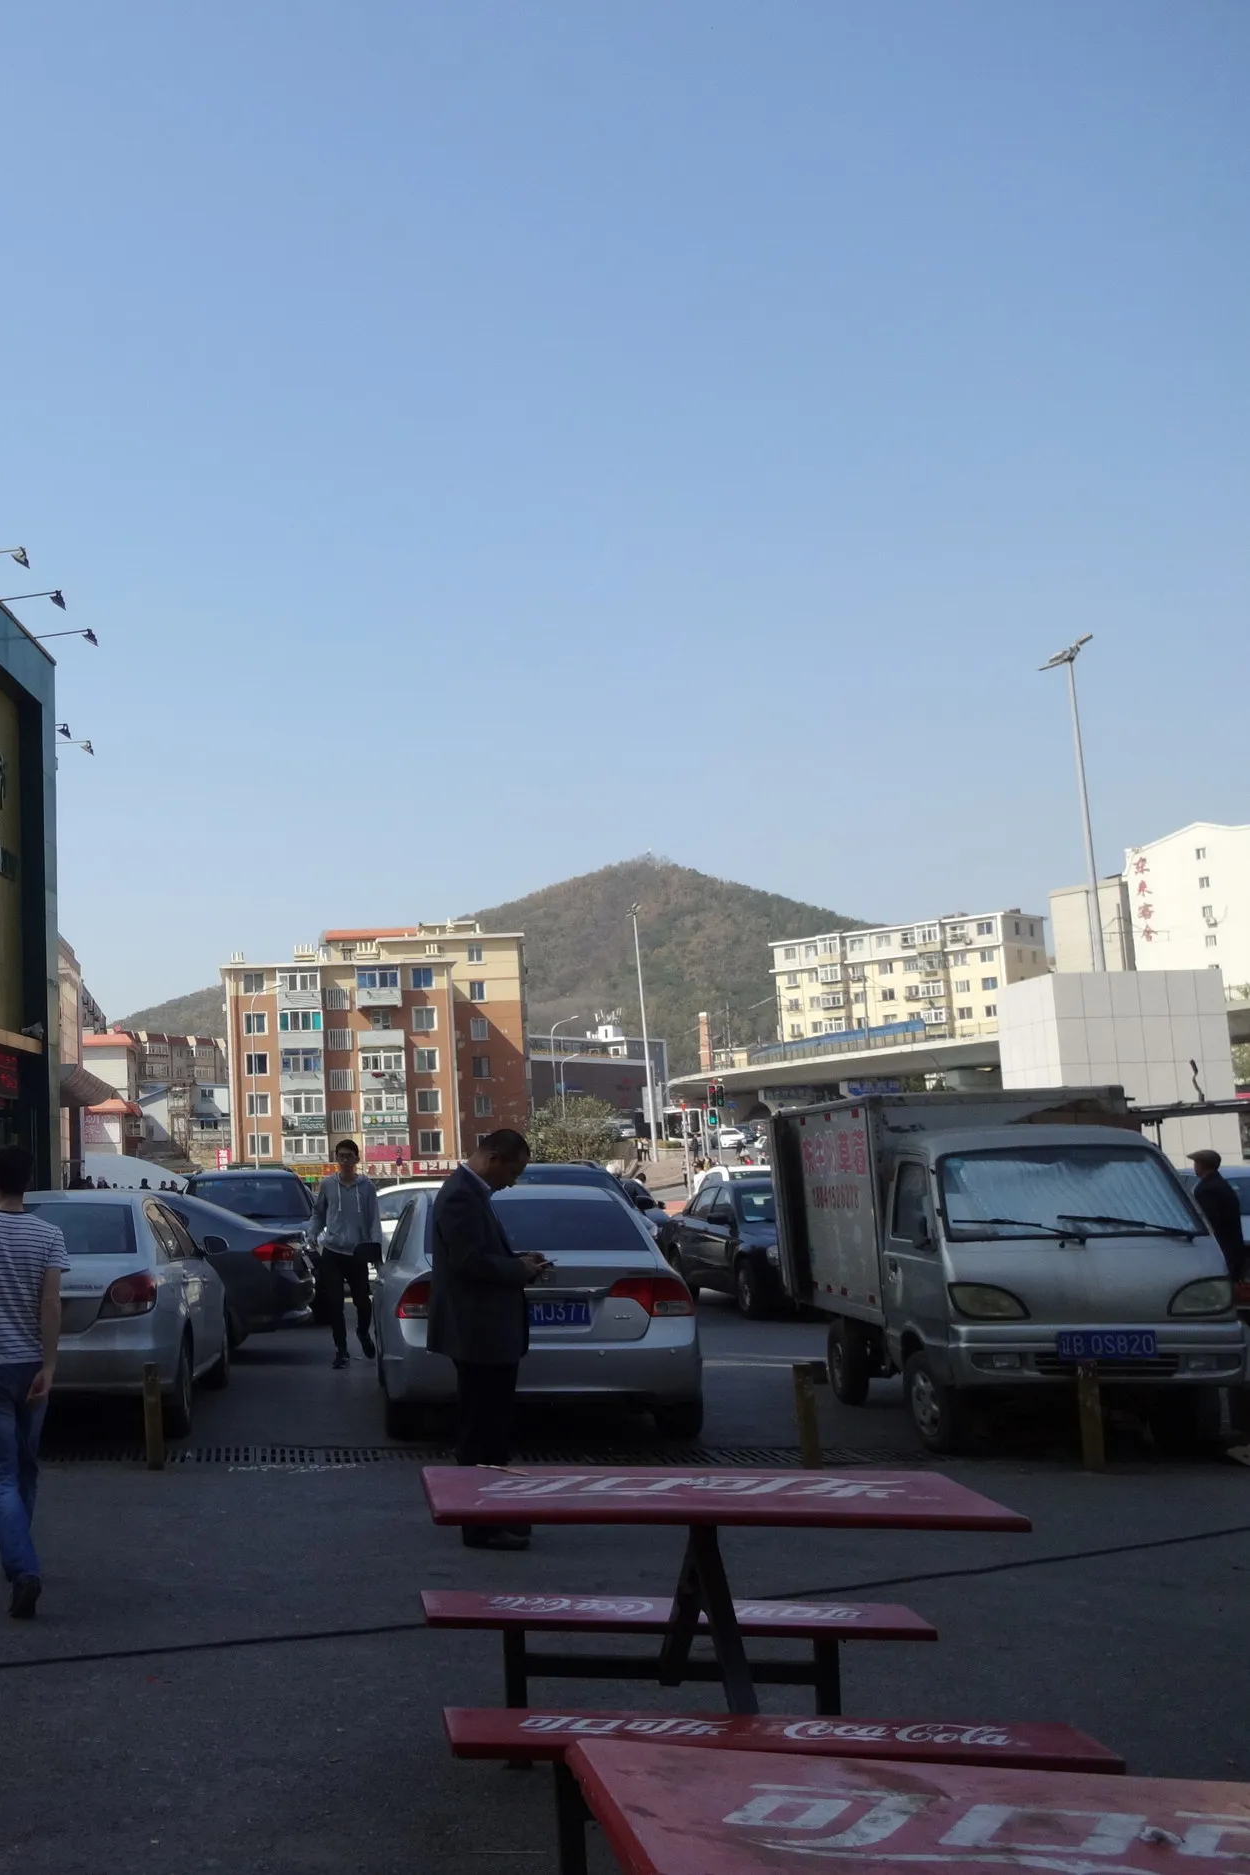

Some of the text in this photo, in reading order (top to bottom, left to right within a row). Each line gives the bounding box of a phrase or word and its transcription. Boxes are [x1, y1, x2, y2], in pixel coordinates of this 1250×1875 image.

[533, 1302, 587, 1321] MJ377
[477, 1475, 906, 1500] 可口可乐
[518, 1715, 734, 1737] 可口可乐
[783, 1719, 1013, 1747] Coca-Cola
